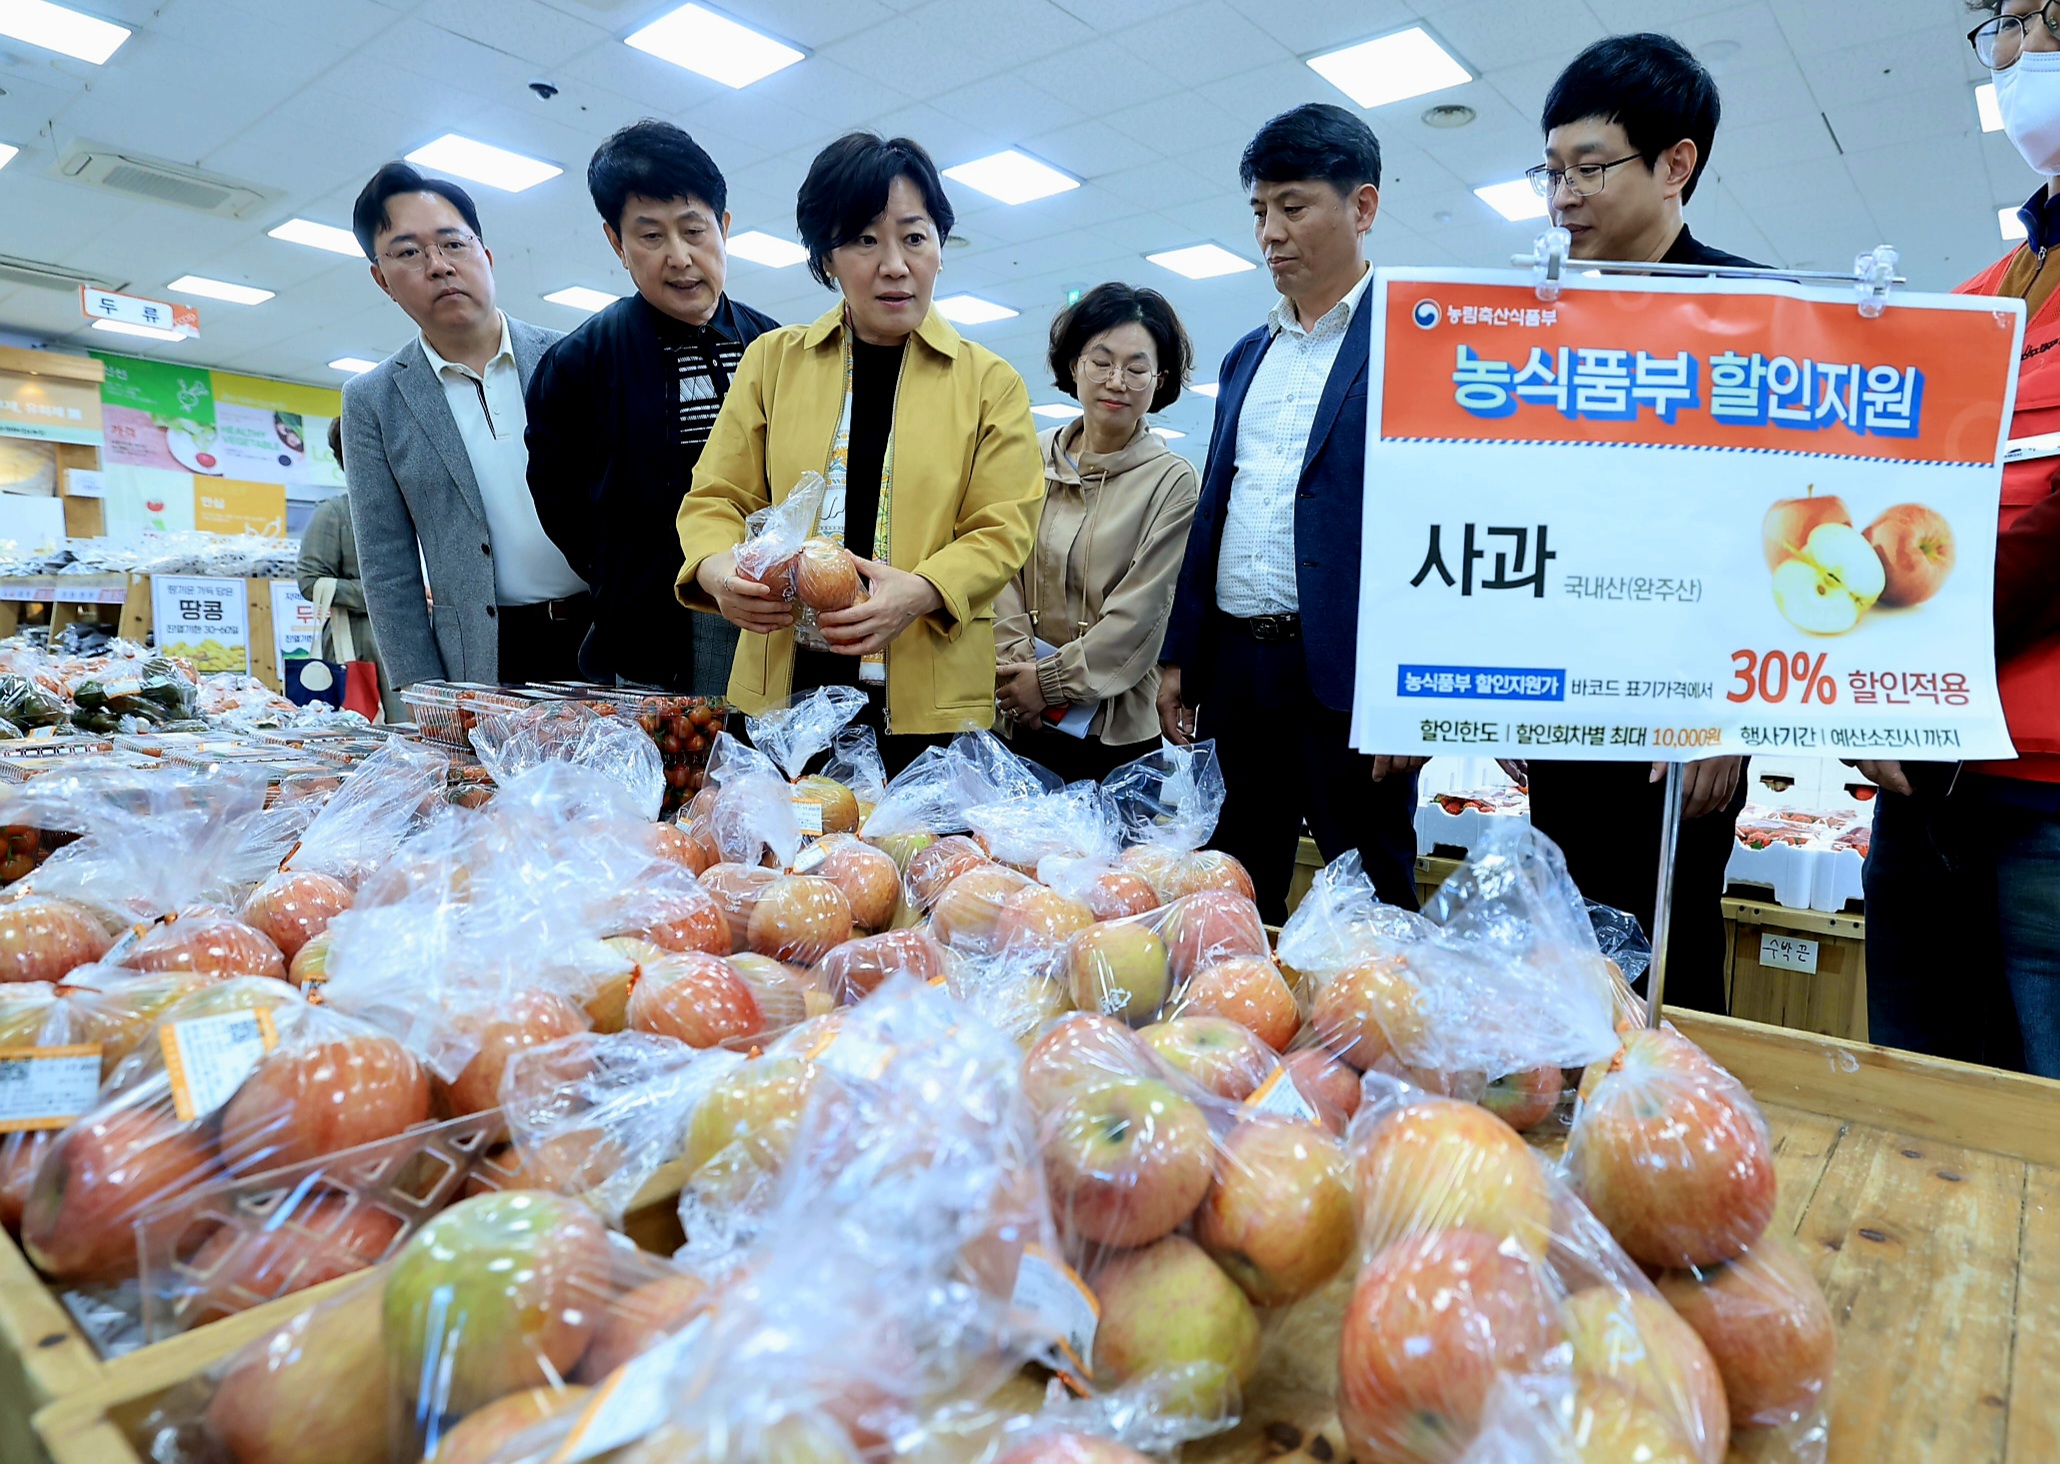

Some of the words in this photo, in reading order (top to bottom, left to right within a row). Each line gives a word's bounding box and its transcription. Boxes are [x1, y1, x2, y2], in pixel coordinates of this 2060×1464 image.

[1447, 305, 1557, 327] 농림축산식품부
[1452, 344, 1697, 422] 농식품부
[1709, 351, 1924, 436] 할인지원
[1410, 523, 1556, 598] 사과
[1564, 575, 1702, 602] 국내산(완주산)
[179, 599, 223, 621] 땅콩
[1405, 672, 1471, 693] 농식품부
[1475, 673, 1559, 696] 할인지원가
[1572, 679, 1620, 697] 바코드
[1625, 680, 1713, 699] 표기가격에서
[1726, 649, 1837, 705] 30%
[1848, 670, 1970, 706] 할인적용
[1421, 719, 1498, 743] 할인한도
[1516, 723, 1605, 746] 할인회차별
[1610, 726, 1647, 747] 최대
[1652, 727, 1722, 748] 10,000원
[1741, 725, 1816, 748] 행사기간
[1831, 727, 1920, 748] 예산소진시
[1924, 729, 1961, 748] 까지
